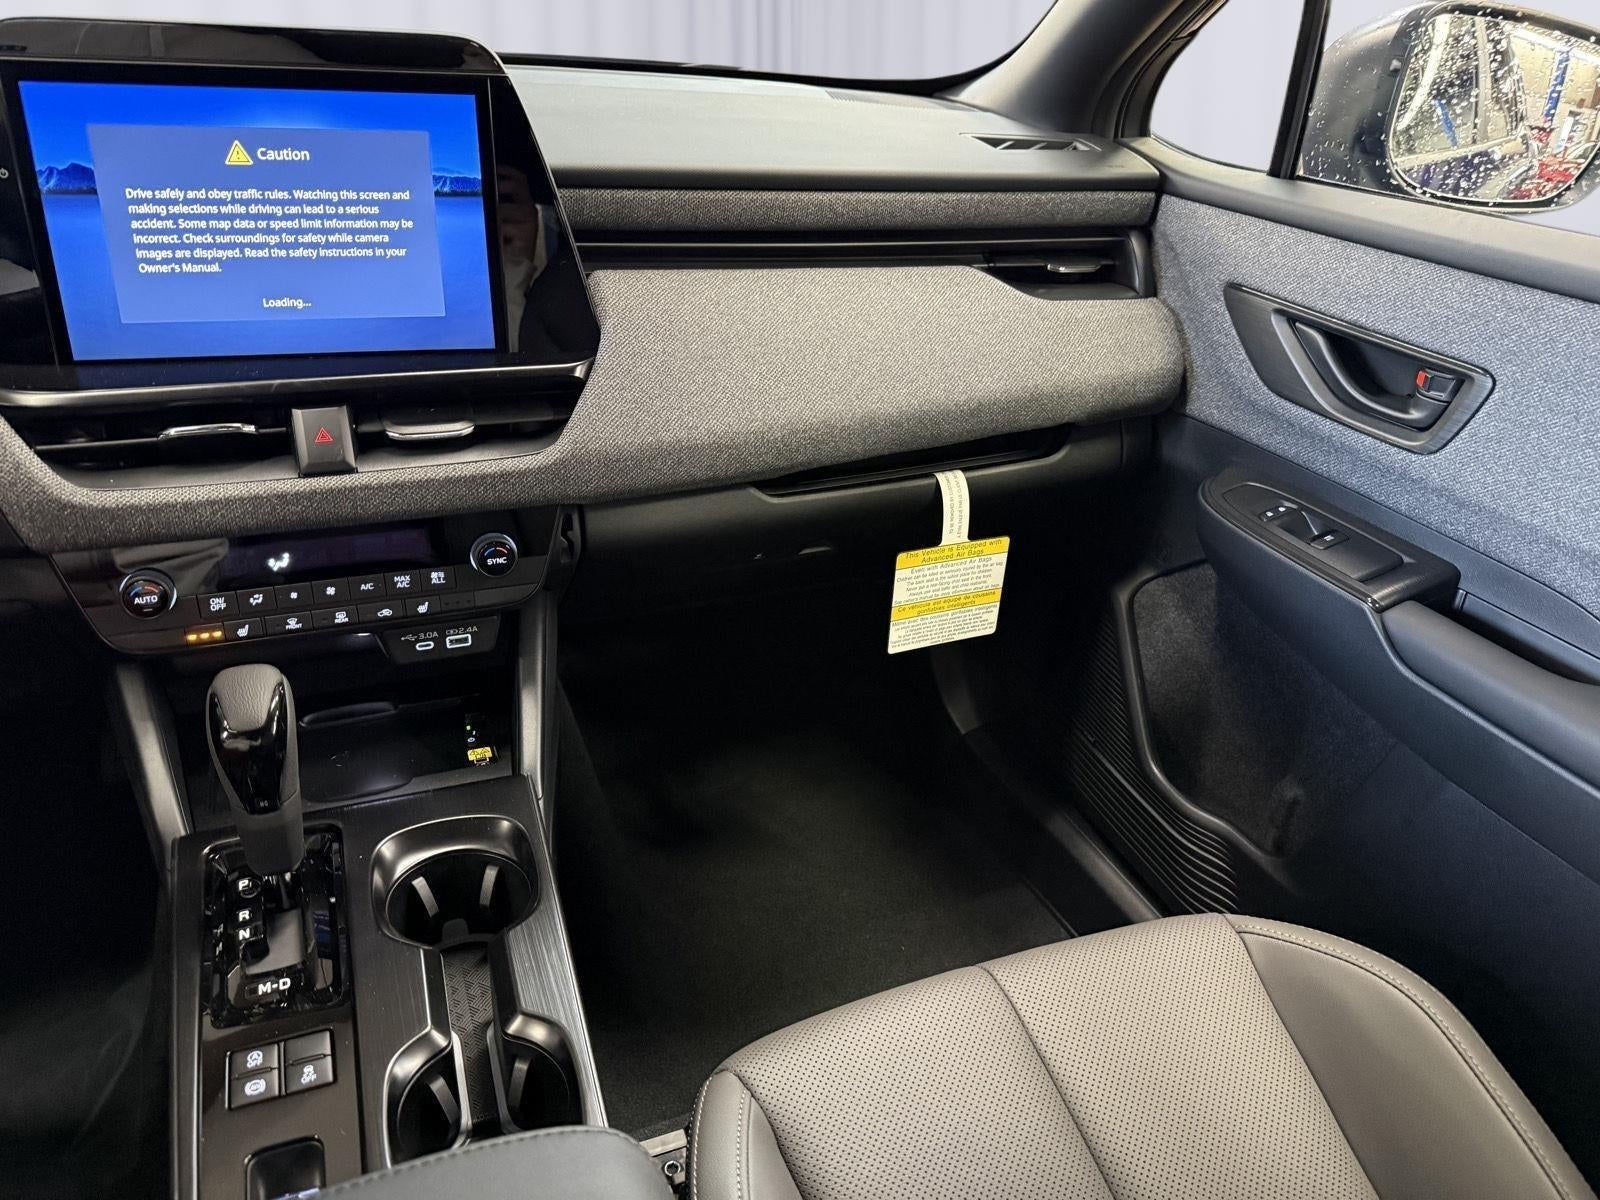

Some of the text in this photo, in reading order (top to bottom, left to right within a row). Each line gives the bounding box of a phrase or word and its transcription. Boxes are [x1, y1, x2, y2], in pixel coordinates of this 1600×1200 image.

[257, 147, 310, 161] Caution
[125, 188, 410, 201] Drive safely and obey traffic rules. Watching this screen and
[128, 203, 380, 216] making selections while driving can lead to a serious
[131, 219, 413, 231] accident. Some map data or speed limit information may be
[133, 233, 389, 245] incorrect. Check surroundings for safety while camera
[135, 247, 407, 260] images are displayed. Read the safety instructions in your
[138, 263, 222, 273] Owner's Manual.
[262, 298, 312, 309] Loading...
[921, 548, 945, 556] Vehicle
[956, 541, 986, 551] Equipped
[487, 556, 507, 565] SYNC
[921, 553, 953, 562] Advanced
[967, 548, 983, 556] Bags
[940, 560, 966, 568] Advanced
[394, 575, 411, 583] MAX
[431, 576, 446, 584] ALL
[360, 583, 375, 591] A/C
[396, 581, 411, 589] A/C
[134, 595, 158, 605] AUTO
[210, 597, 225, 605] ON/
[210, 603, 227, 612] OFF
[458, 625, 478, 634] 2.4A
[418, 631, 439, 640] 3.0A
[238, 879, 249, 891] P
[238, 910, 250, 922] R
[238, 928, 250, 941] N
[258, 978, 291, 996] M-D
